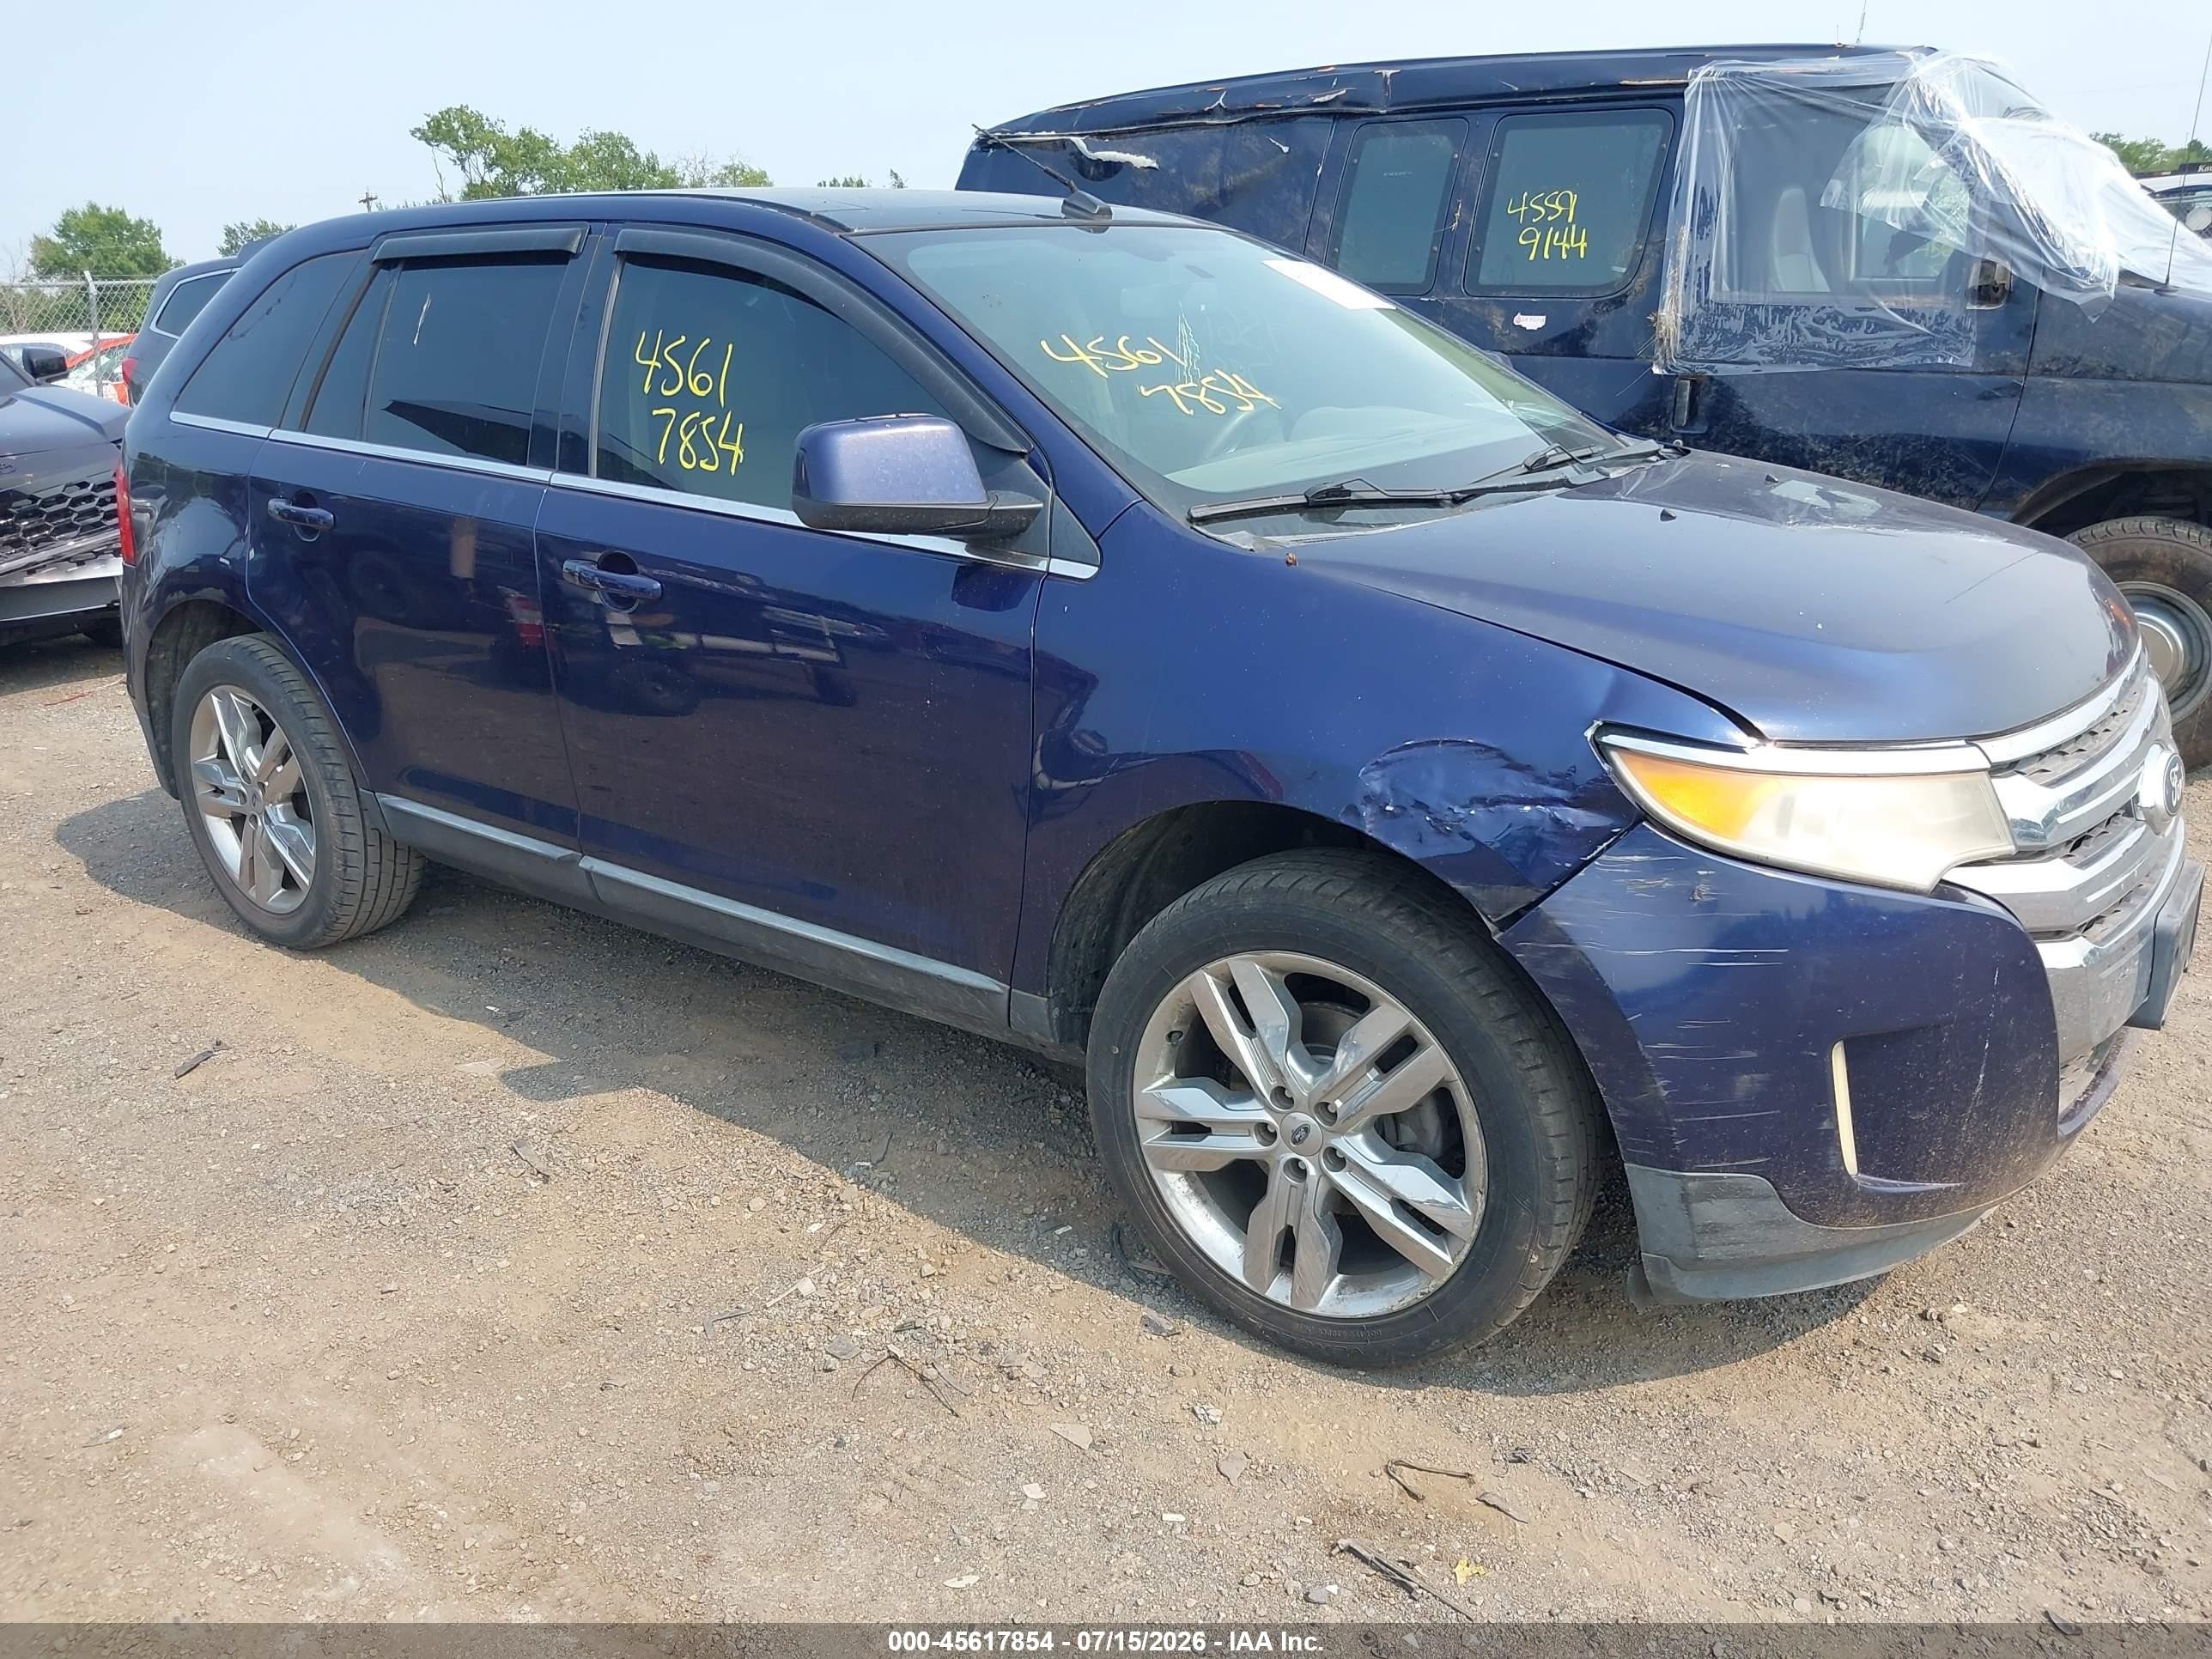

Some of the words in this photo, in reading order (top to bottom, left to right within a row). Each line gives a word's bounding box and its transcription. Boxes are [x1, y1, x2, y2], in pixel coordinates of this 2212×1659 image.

[1507, 190, 1577, 224] 4559
[1518, 224, 1587, 260] 9144
[635, 329, 733, 409] 4561
[1040, 334, 1187, 378] 4561
[1137, 368, 1282, 416] 7854
[653, 408, 744, 477] 7854
